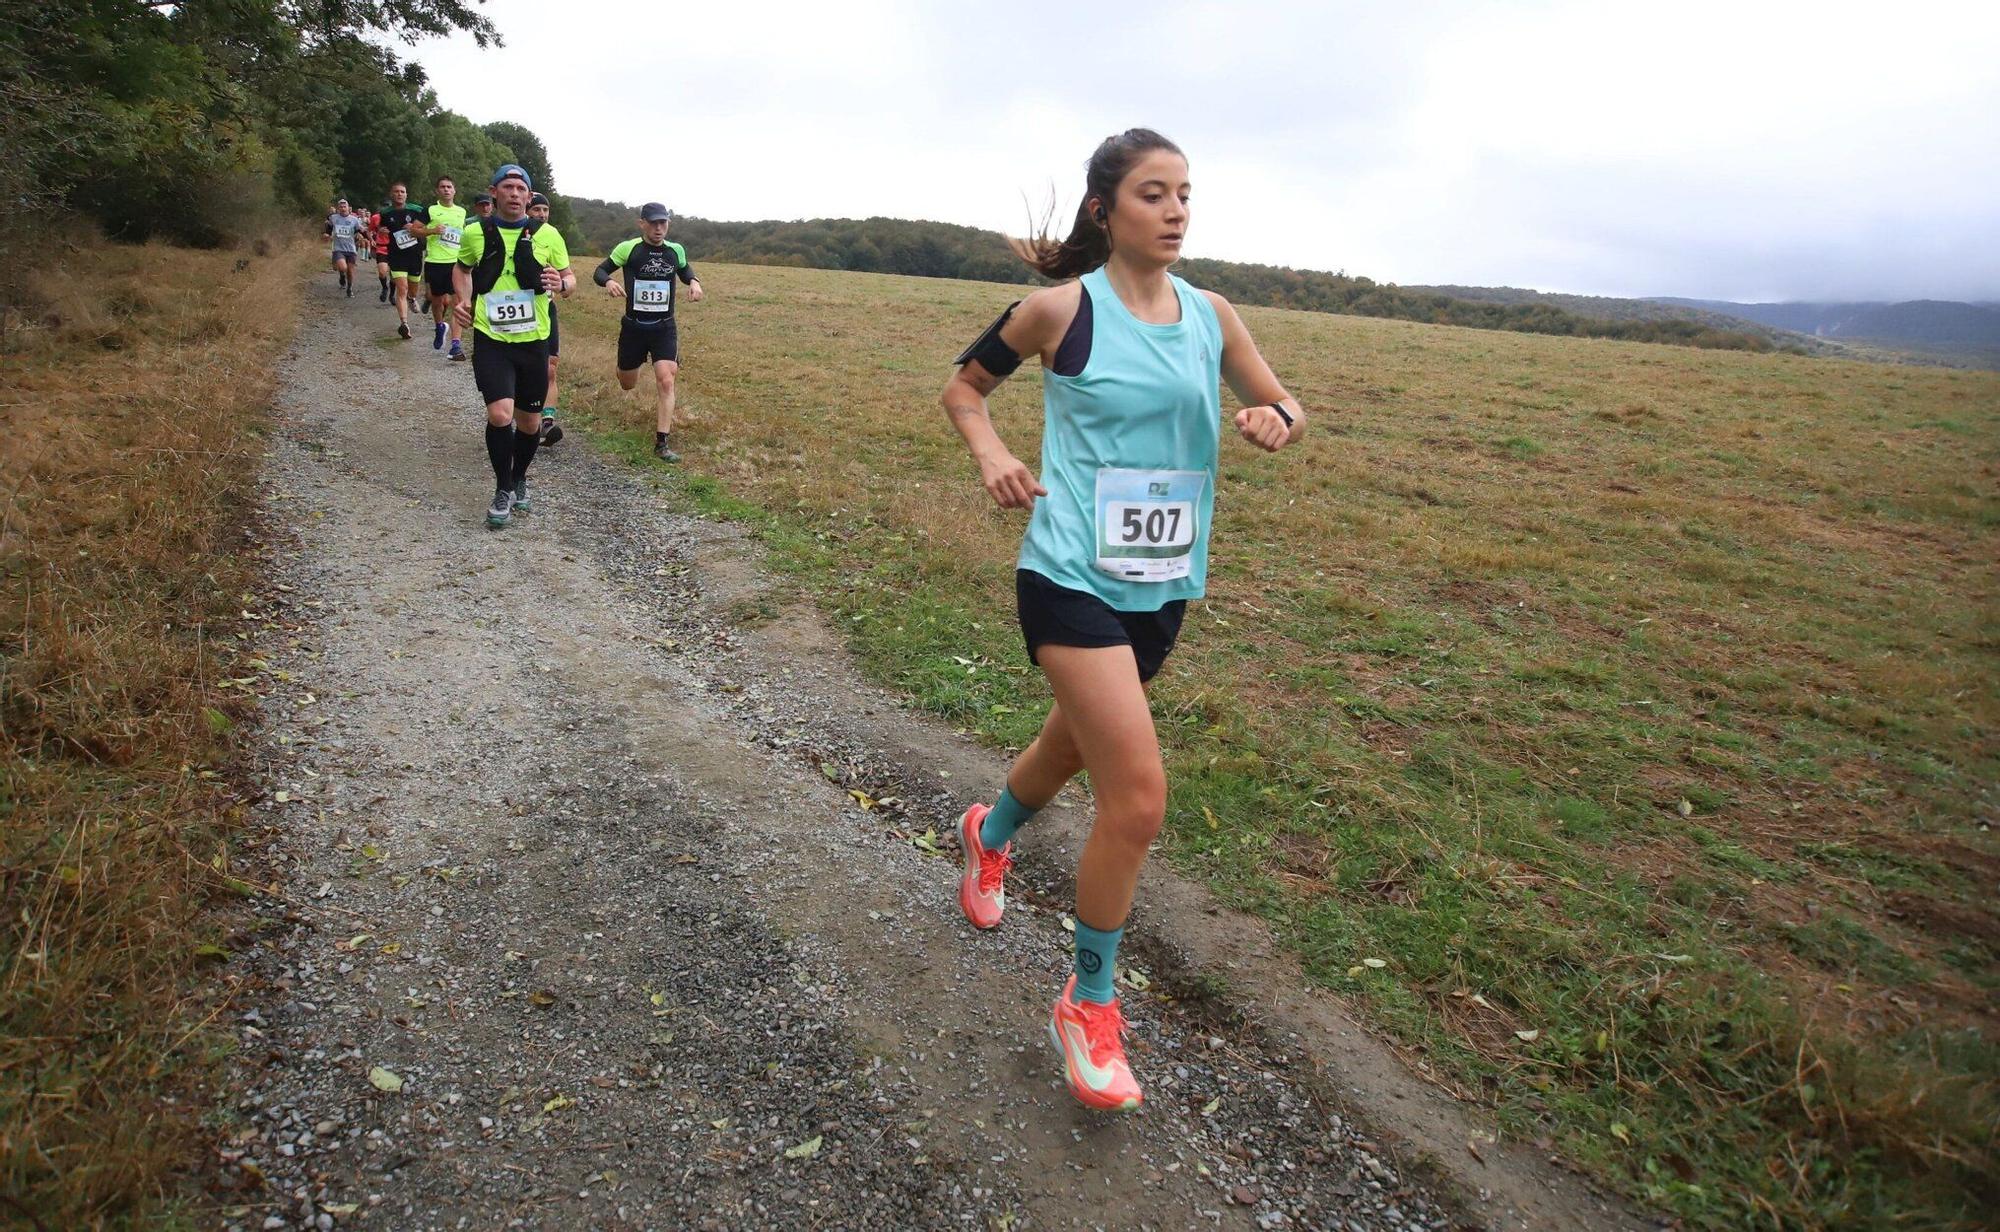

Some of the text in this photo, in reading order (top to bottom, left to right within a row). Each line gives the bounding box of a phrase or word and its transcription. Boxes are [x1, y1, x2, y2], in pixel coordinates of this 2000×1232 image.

[445, 232, 458, 241] 451
[641, 290, 663, 301] 813
[497, 303, 525, 320] 591
[1122, 508, 1181, 543] 507
